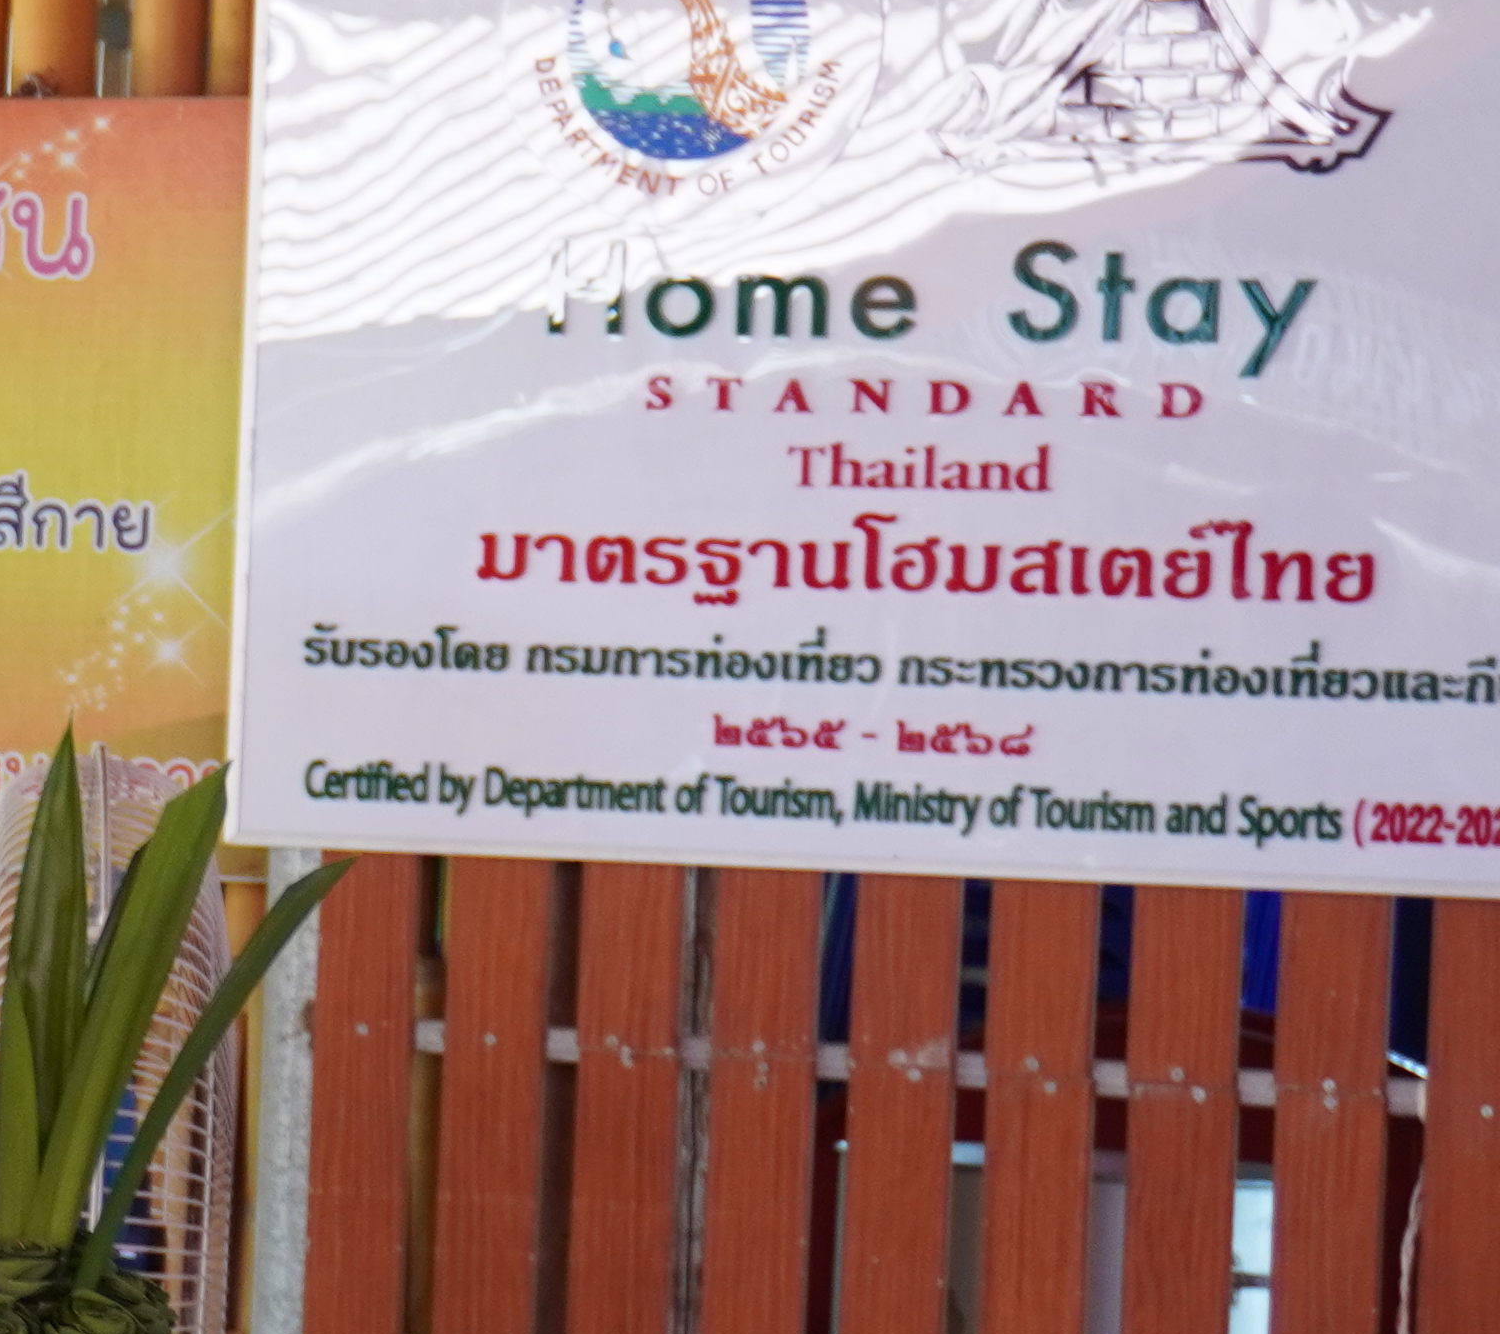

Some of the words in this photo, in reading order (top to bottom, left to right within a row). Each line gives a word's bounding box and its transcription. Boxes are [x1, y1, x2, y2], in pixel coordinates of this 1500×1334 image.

[533, 56, 684, 196] DEPARTMENT
[698, 170, 734, 197] OF
[751, 60, 841, 176] TOURISM
[548, 240, 918, 341] Home
[1007, 239, 1318, 379] Stay
[645, 376, 1205, 421] STANDARD
[788, 442, 1053, 493] Thailand
[476, 513, 1377, 606] มาตรฐานโฮมสเตย์ไทย
[303, 623, 511, 670] รับรองโดย
[526, 628, 882, 685] กรมการท่องเที่ยว
[897, 640, 1500, 703] กระทรวงการท่องเที่ยวและกี
[304, 760, 430, 804] Certified
[439, 763, 474, 816] by
[484, 764, 667, 817] Department
[674, 775, 710, 813] of
[717, 776, 844, 827] Tourism,
[854, 782, 981, 837] Ministry
[989, 785, 1026, 827] of
[1030, 787, 1156, 834] Tourism
[1166, 792, 1227, 837] and
[1238, 796, 1343, 848] Sports
